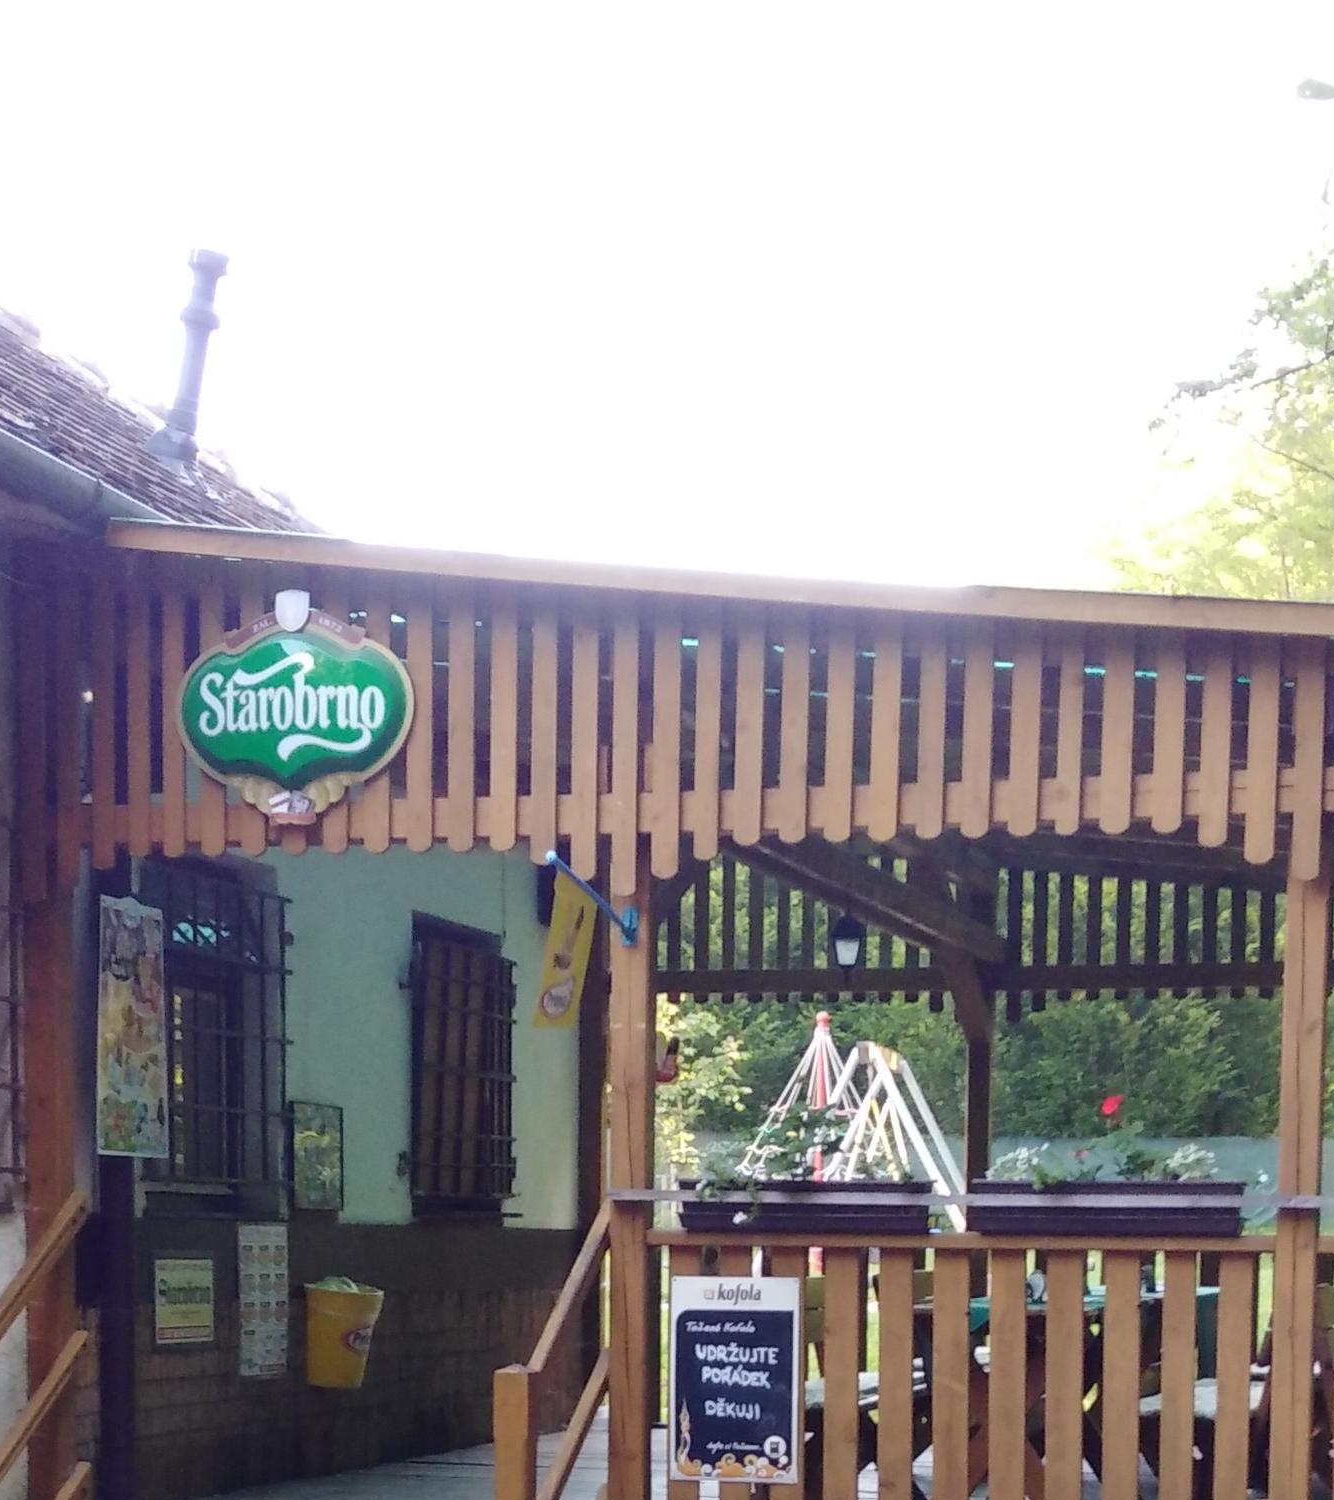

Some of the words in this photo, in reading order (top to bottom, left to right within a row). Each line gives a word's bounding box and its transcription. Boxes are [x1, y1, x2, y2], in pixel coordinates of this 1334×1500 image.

[199, 651, 386, 762] Starobrno
[717, 1283, 763, 1306] kofola
[694, 1342, 780, 1365] UDRŽUJTE
[701, 1364, 772, 1389] POŘÁDEK
[704, 1397, 762, 1421] DĚKUJI
